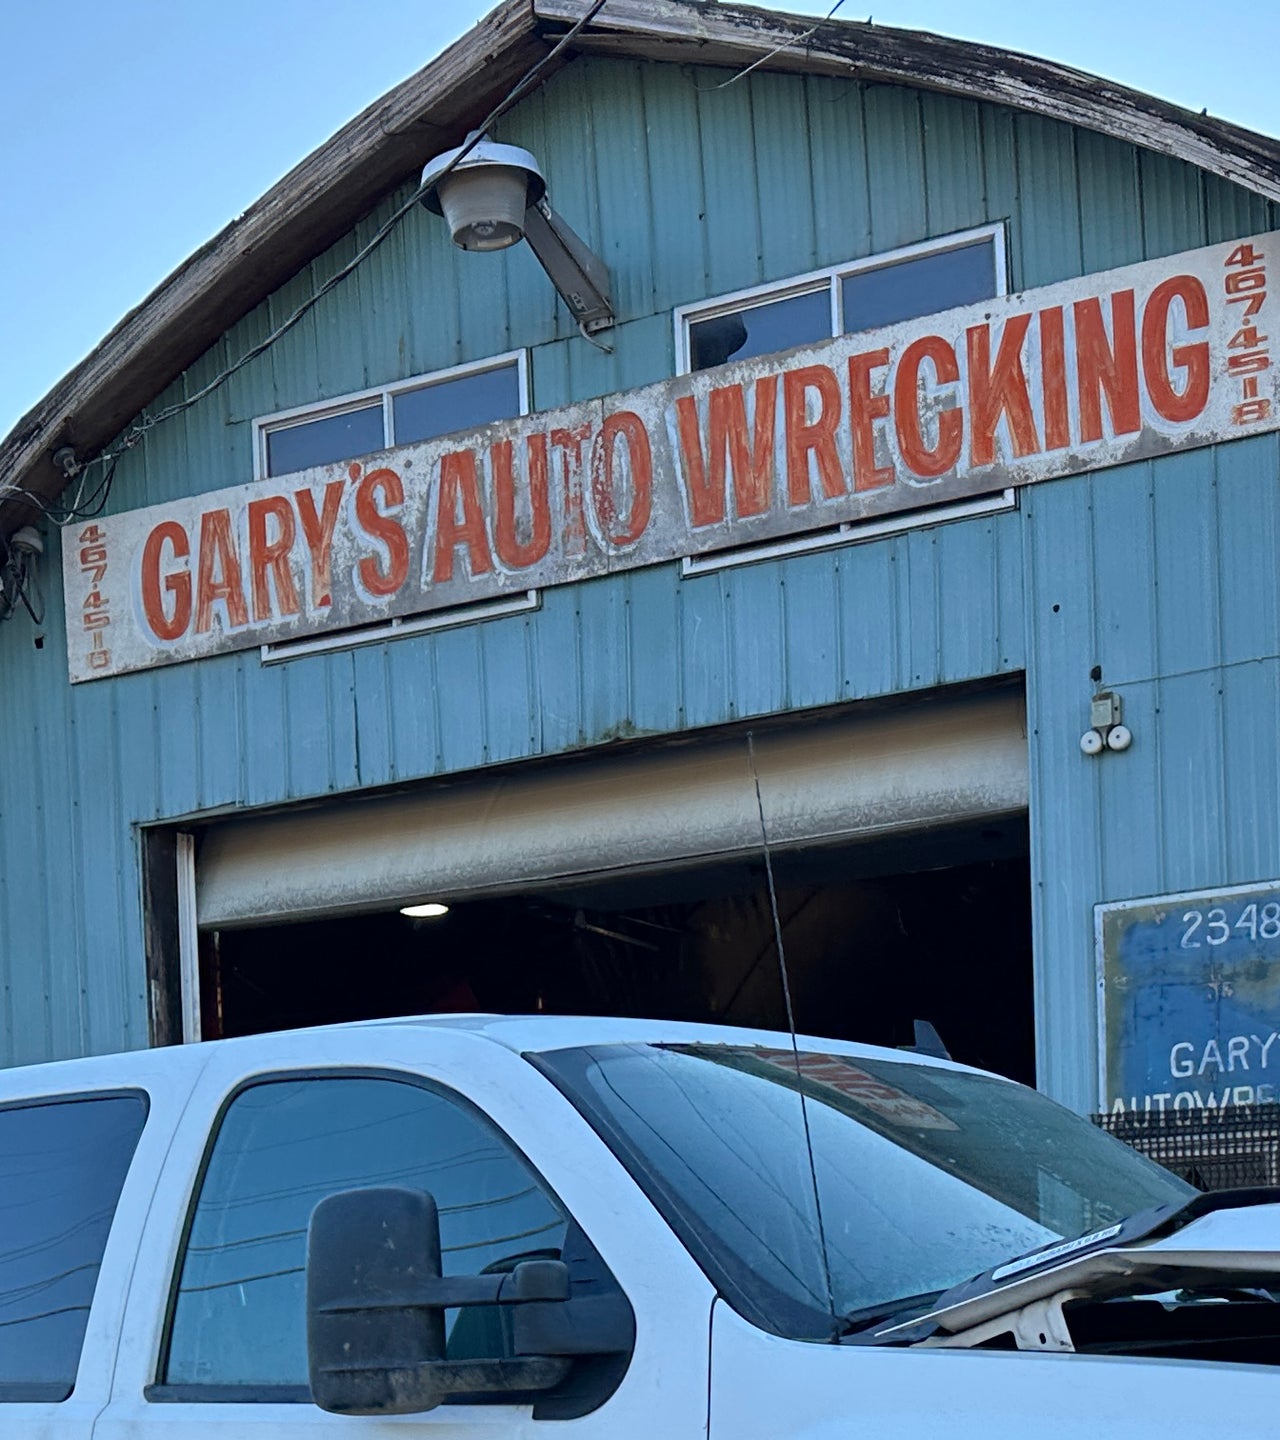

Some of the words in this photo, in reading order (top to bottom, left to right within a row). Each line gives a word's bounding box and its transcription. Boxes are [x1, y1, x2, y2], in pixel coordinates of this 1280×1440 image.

[140, 462, 410, 641] GARY'S
[431, 410, 652, 584] AUTO
[676, 273, 1211, 529] WRECKING
